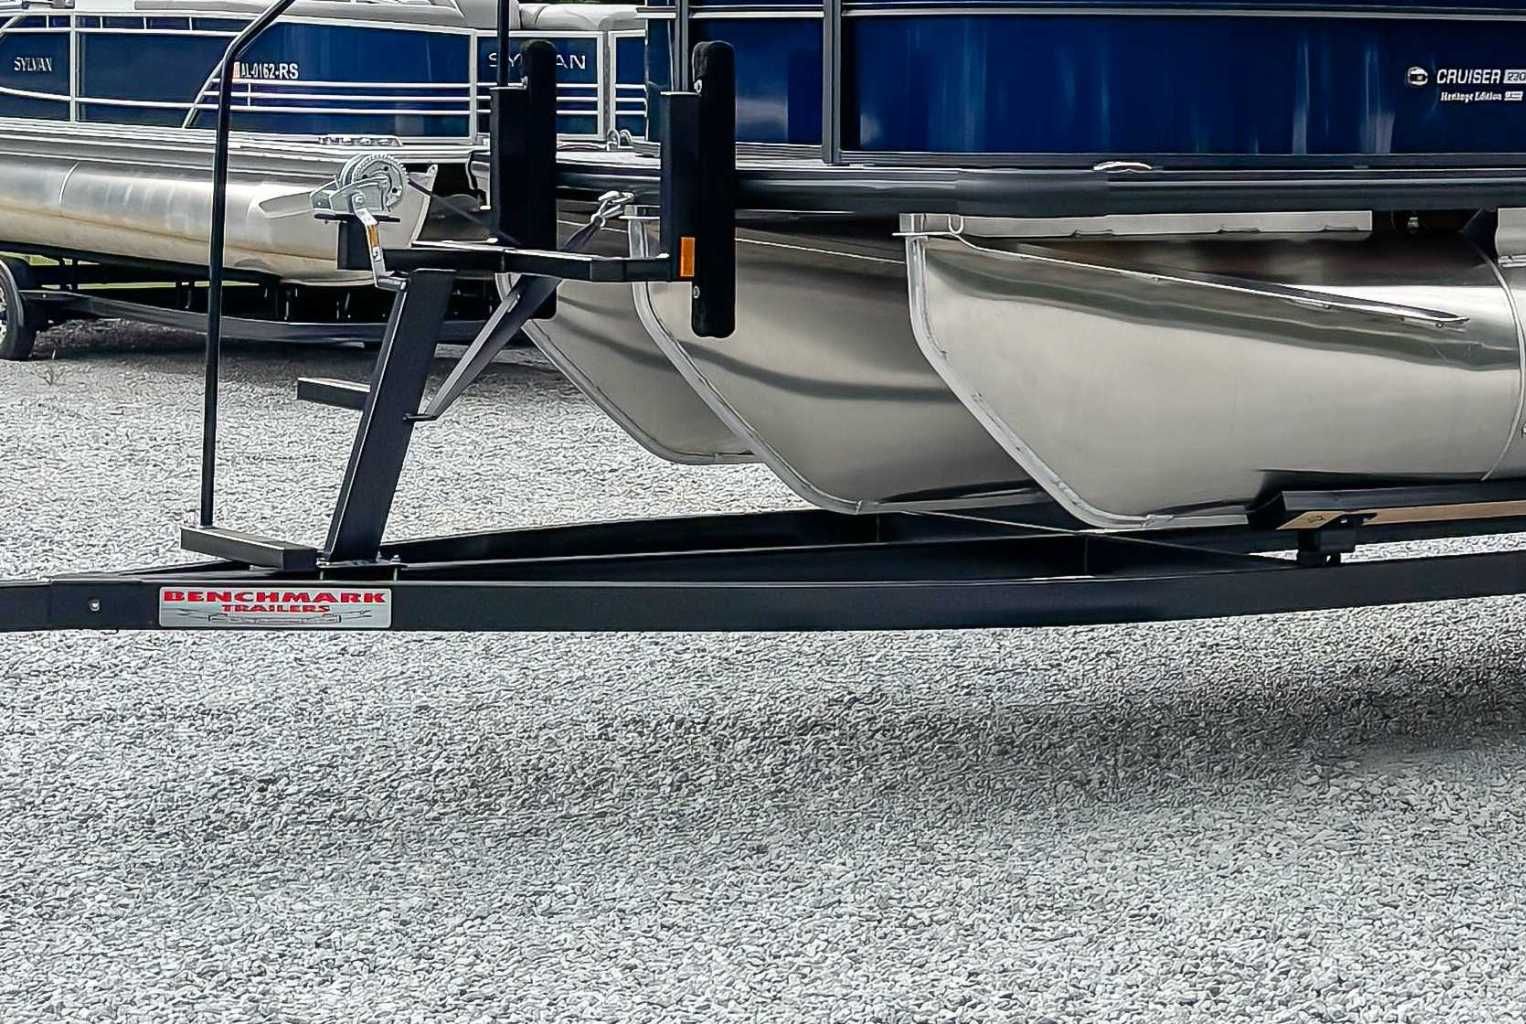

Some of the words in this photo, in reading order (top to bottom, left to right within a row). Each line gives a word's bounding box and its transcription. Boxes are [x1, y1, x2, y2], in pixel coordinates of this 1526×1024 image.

[13, 56, 54, 72] SYLVAN
[488, 52, 586, 70] SYAN
[1436, 69, 1501, 84] CRUISER
[163, 590, 386, 604] BENCHMARK
[221, 604, 331, 613] TRAILERS
